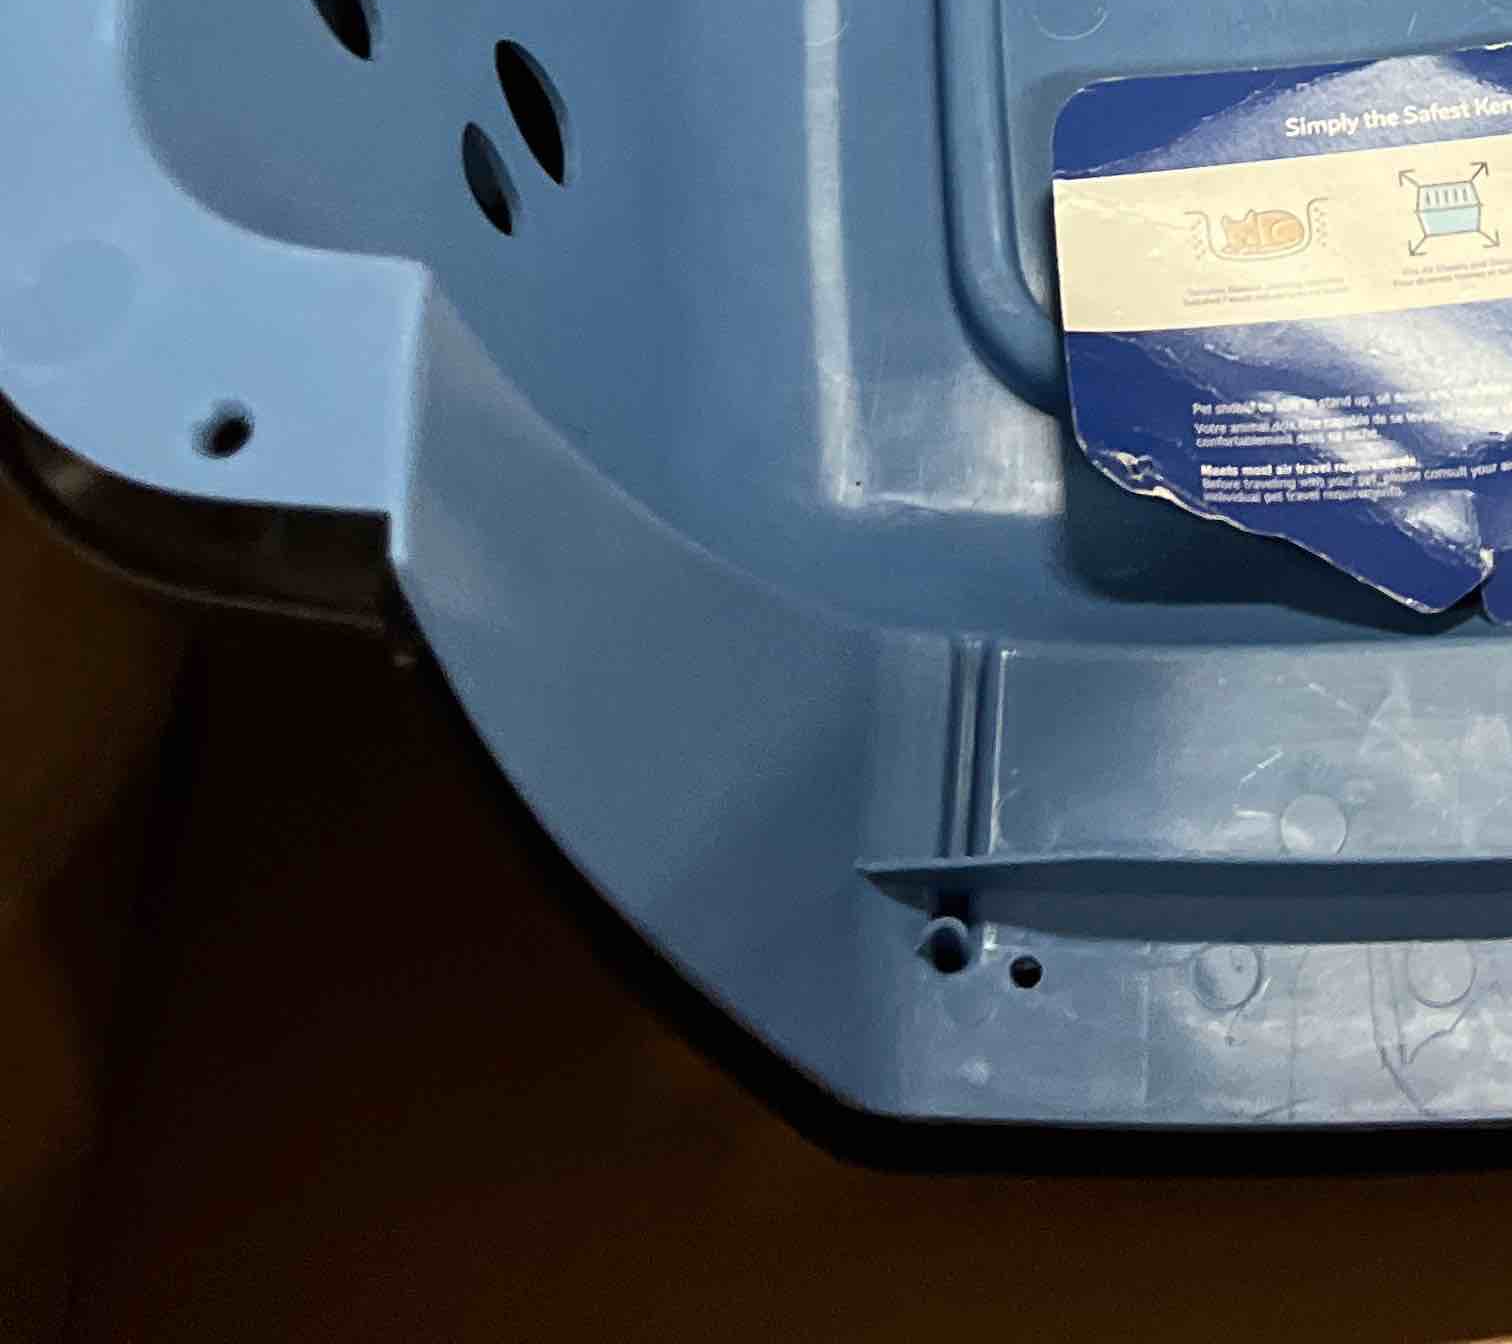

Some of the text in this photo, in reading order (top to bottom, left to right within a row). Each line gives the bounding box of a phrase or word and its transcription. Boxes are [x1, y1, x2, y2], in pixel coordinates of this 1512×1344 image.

[1285, 115, 1360, 139] Simply
[1363, 108, 1399, 129] the
[1403, 100, 1471, 124] Safest
[1201, 465, 1239, 476] Meets
[1471, 463, 1498, 480] your
